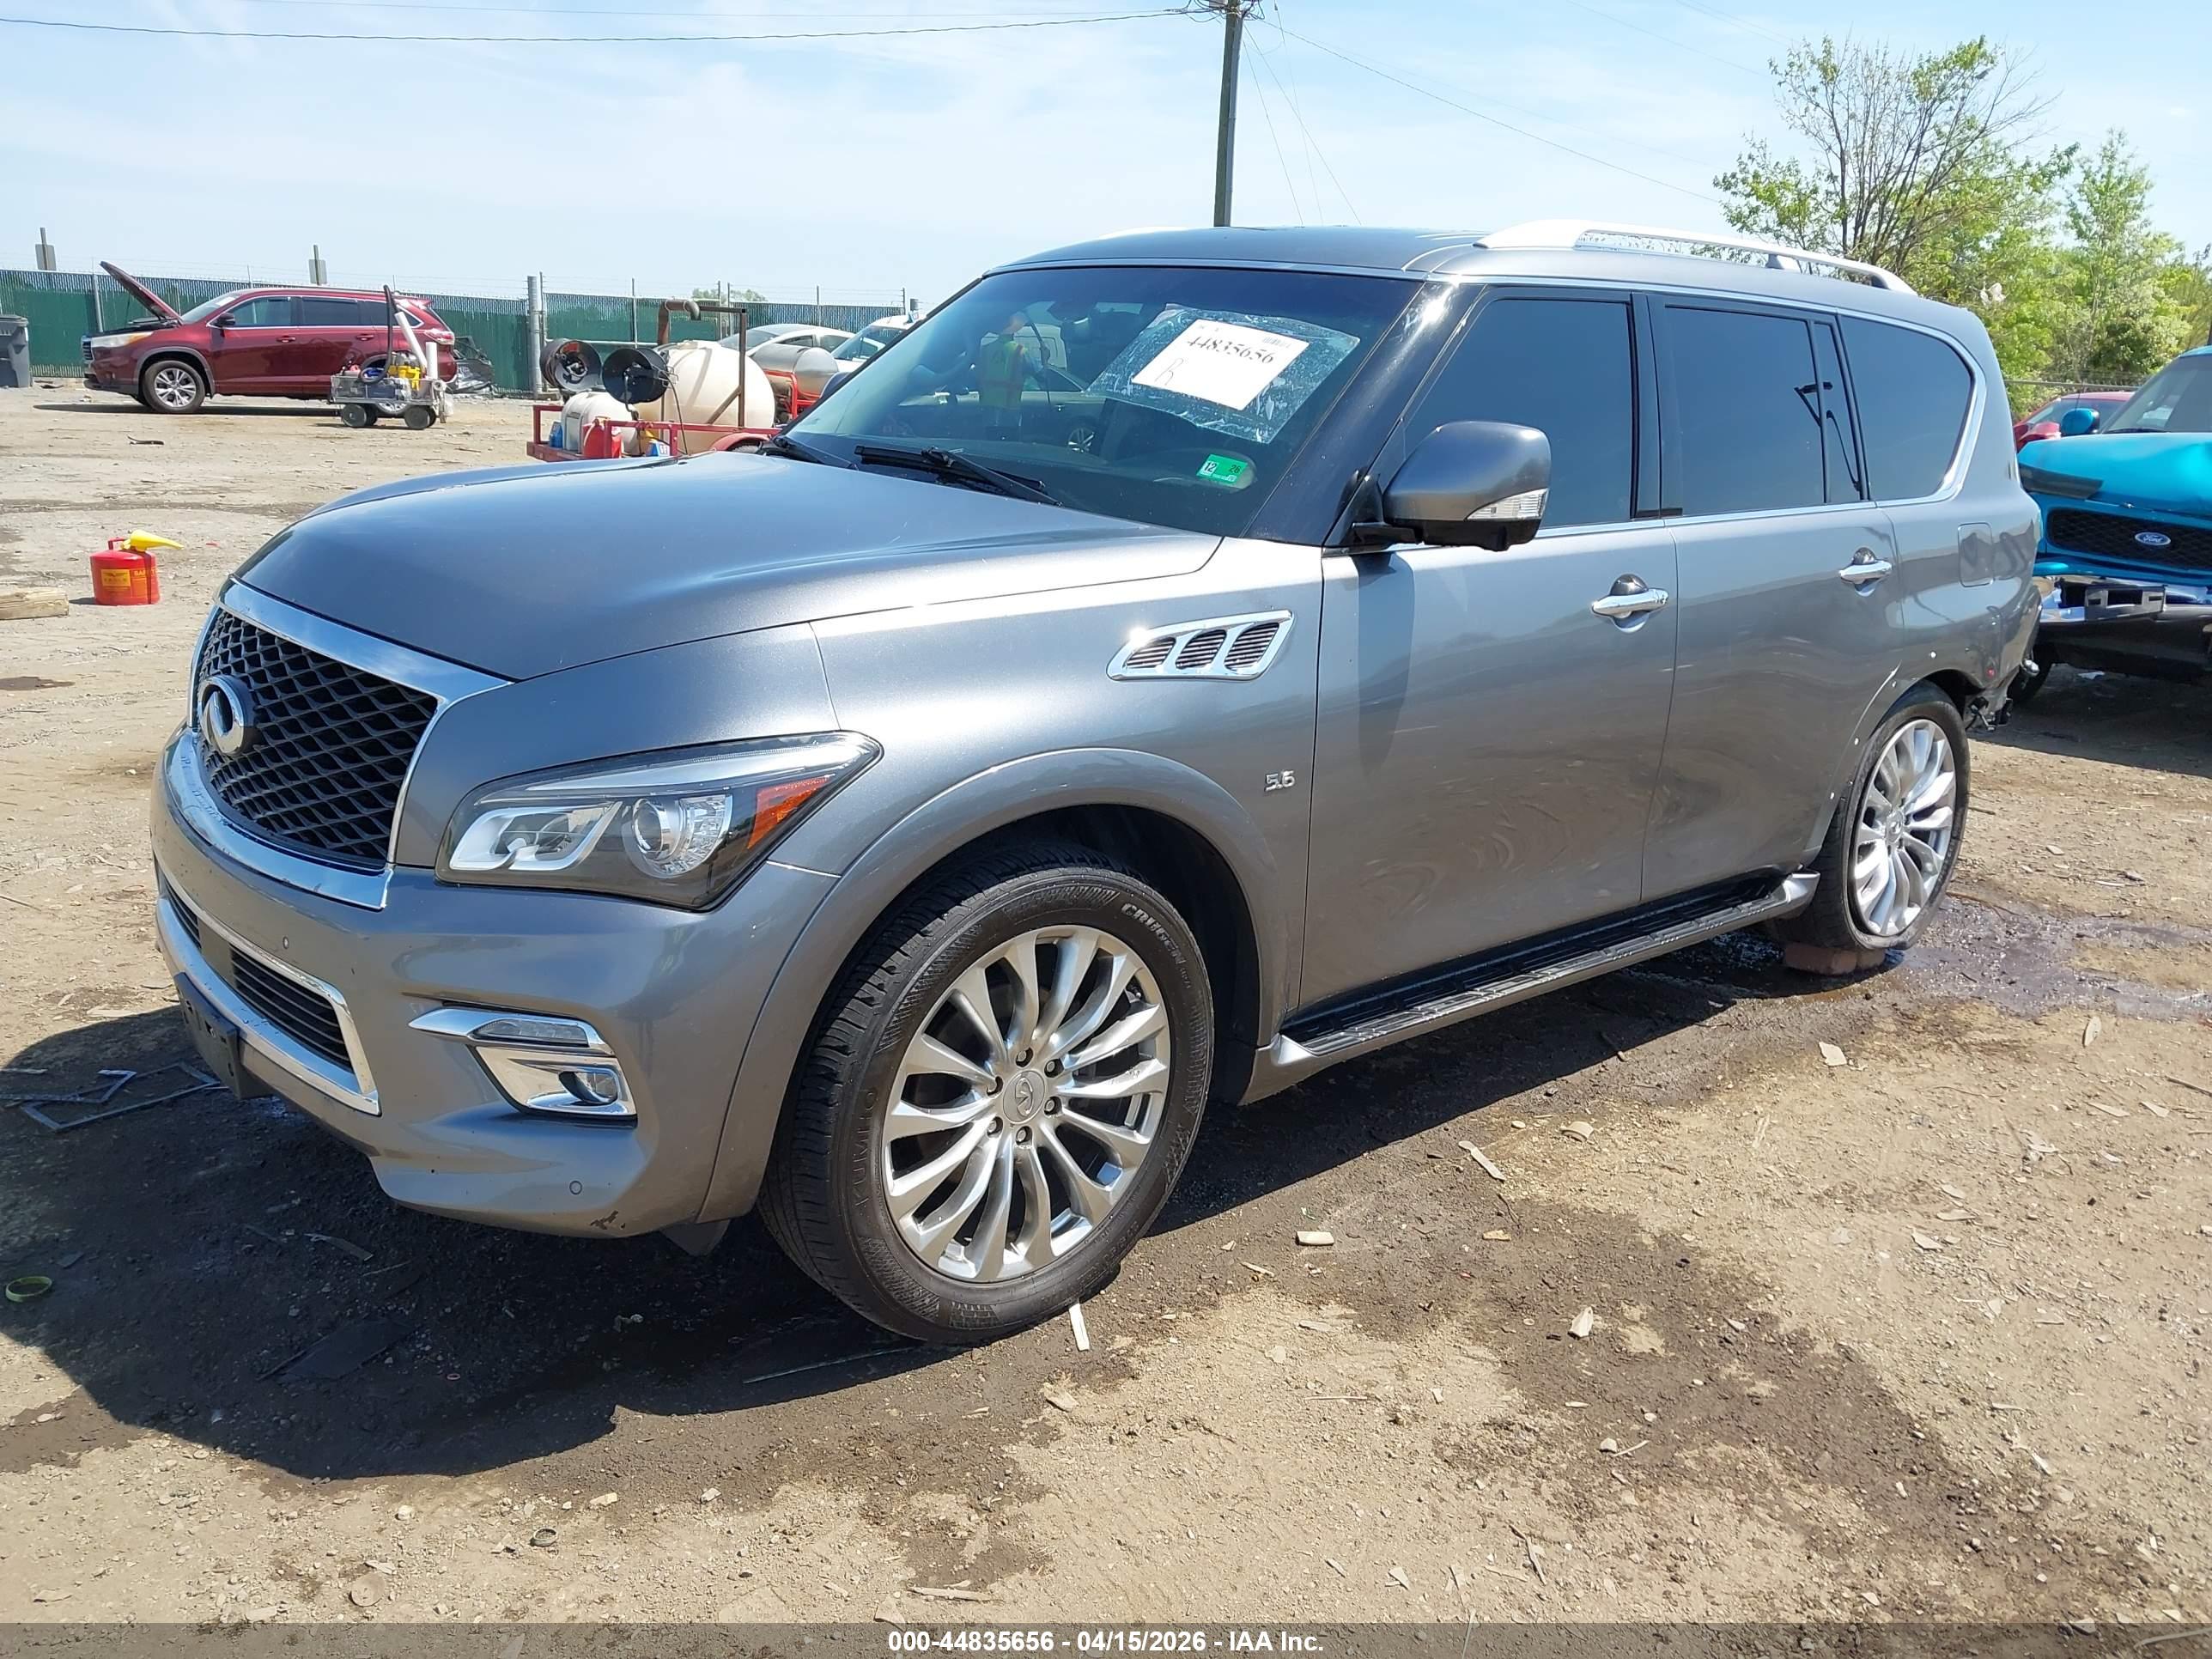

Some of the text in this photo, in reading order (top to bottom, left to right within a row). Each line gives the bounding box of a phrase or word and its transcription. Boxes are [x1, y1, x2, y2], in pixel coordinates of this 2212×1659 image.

[1187, 337, 1275, 364] 44835656
[1204, 462, 1218, 473] 12
[1265, 769, 1296, 792] 5.6
